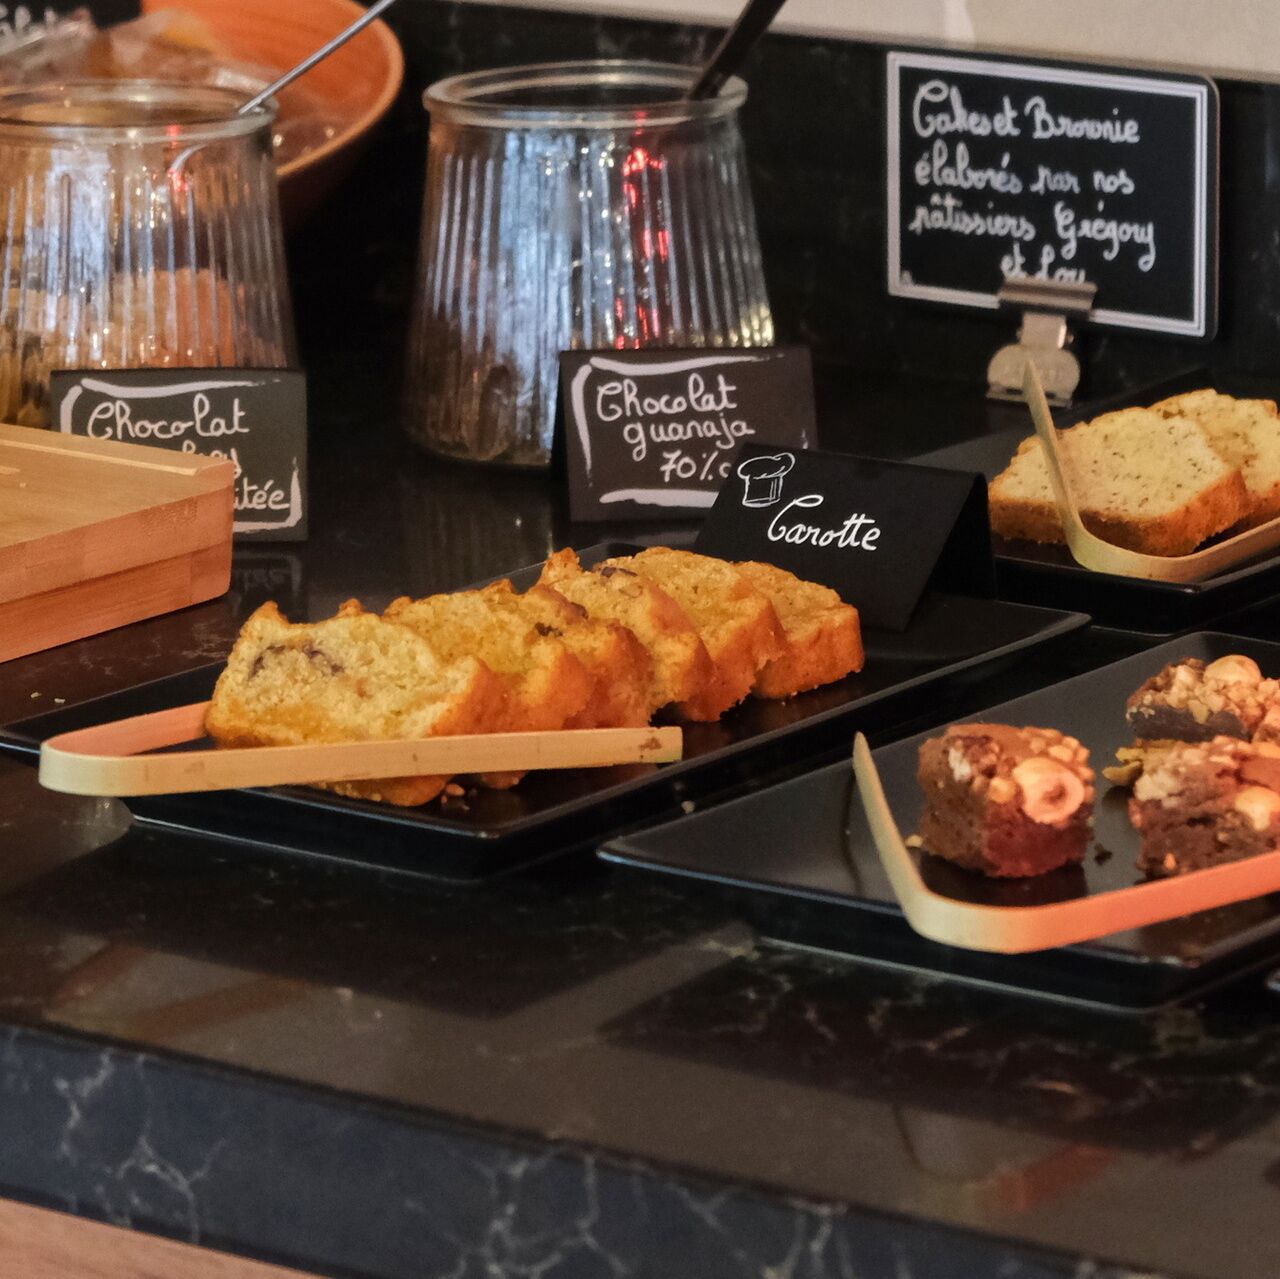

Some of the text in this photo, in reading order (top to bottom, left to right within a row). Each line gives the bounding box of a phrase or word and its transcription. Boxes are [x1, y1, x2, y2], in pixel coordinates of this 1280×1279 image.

[913, 79, 1141, 143] Cakes et Brownie
[915, 138, 1136, 195] élaborés par nos
[1054, 200, 1157, 272] Grégory
[87, 392, 251, 441] Chocolat
[595, 372, 738, 422] Chocolat
[623, 412, 756, 462] guanaja
[767, 494, 882, 551] Carotte
